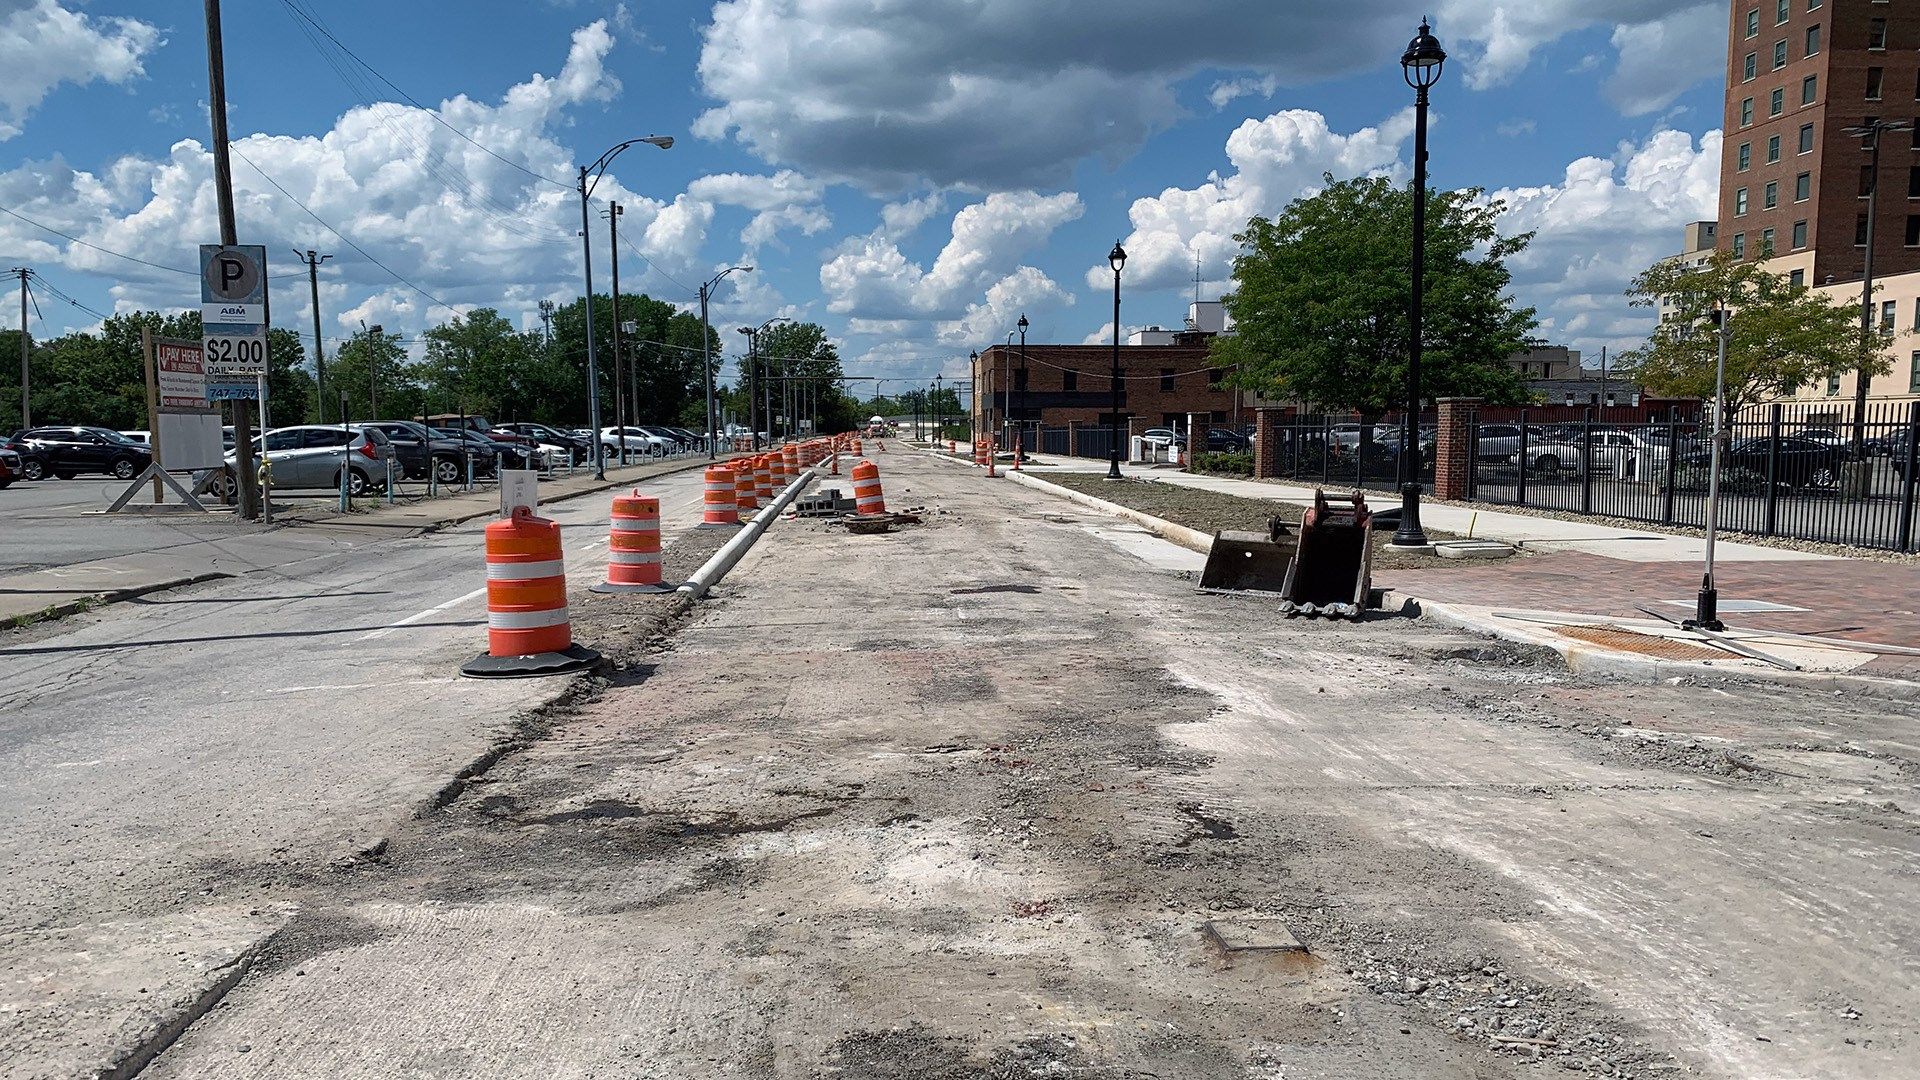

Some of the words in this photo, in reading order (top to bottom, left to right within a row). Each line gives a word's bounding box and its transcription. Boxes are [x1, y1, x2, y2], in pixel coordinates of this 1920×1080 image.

[221, 258, 244, 291] P
[220, 307, 246, 315] ABM
[166, 347, 180, 361] PAY
[181, 349, 200, 363] HERE
[207, 338, 263, 365] $2.00
[208, 366, 234, 375] DAILY
[239, 366, 265, 375] RATE
[210, 388, 260, 398] 747-767
